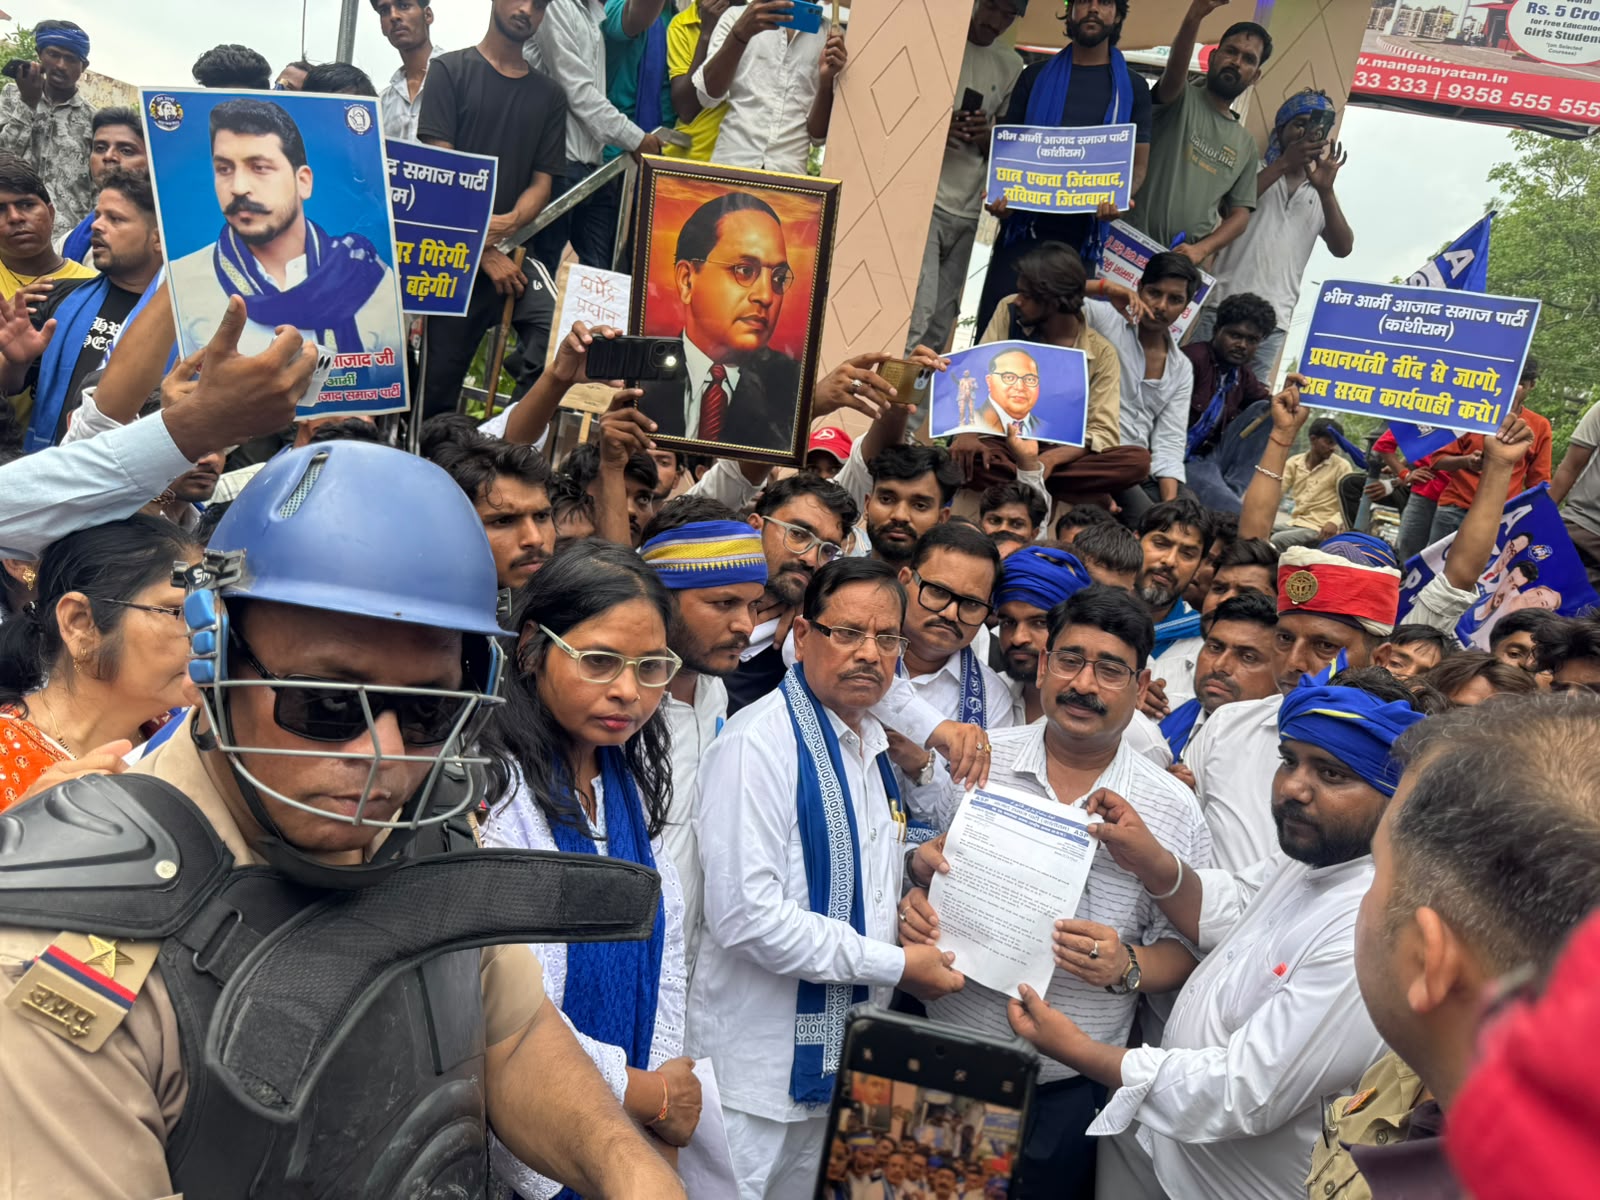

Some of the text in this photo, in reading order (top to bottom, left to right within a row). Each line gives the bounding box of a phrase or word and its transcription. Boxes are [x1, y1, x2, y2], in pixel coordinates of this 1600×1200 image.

[1526, 2, 1550, 15] Rs.
[1555, 5, 1567, 17] 5
[1524, 27, 1553, 38] Girls
[1354, 72, 1381, 88] 33
[1387, 76, 1428, 94] 333
[1448, 84, 1503, 104] 9358
[1508, 92, 1552, 111] 555
[1558, 98, 1600, 119] 555
[997, 130, 1130, 144] भीम आर्मी आजाद समाज पार्टी
[402, 161, 455, 186] समाज
[458, 169, 490, 192] पार्टी
[1026, 170, 1062, 187] एकता
[1066, 170, 1124, 188] जिंदाबाद,
[418, 238, 471, 274] गिरेगी,
[406, 271, 458, 302] बढ़ेगी।
[1323, 288, 1530, 328] भीम आर्मी आजाद समाज पार्टी
[1378, 314, 1454, 342] (कांशीराम)
[374, 348, 394, 366] जी
[326, 372, 356, 386] आर्मी
[1392, 355, 1426, 380] नींद
[1430, 359, 1448, 384] से
[1452, 366, 1502, 396] जागो,
[346, 390, 378, 400] समाज
[380, 382, 400, 398] पार्टी
[1334, 380, 1376, 404] सख्त
[1379, 387, 1454, 416] कार्यवाही
[1458, 398, 1501, 424] करो।
[1074, 829, 1089, 838] ASP
